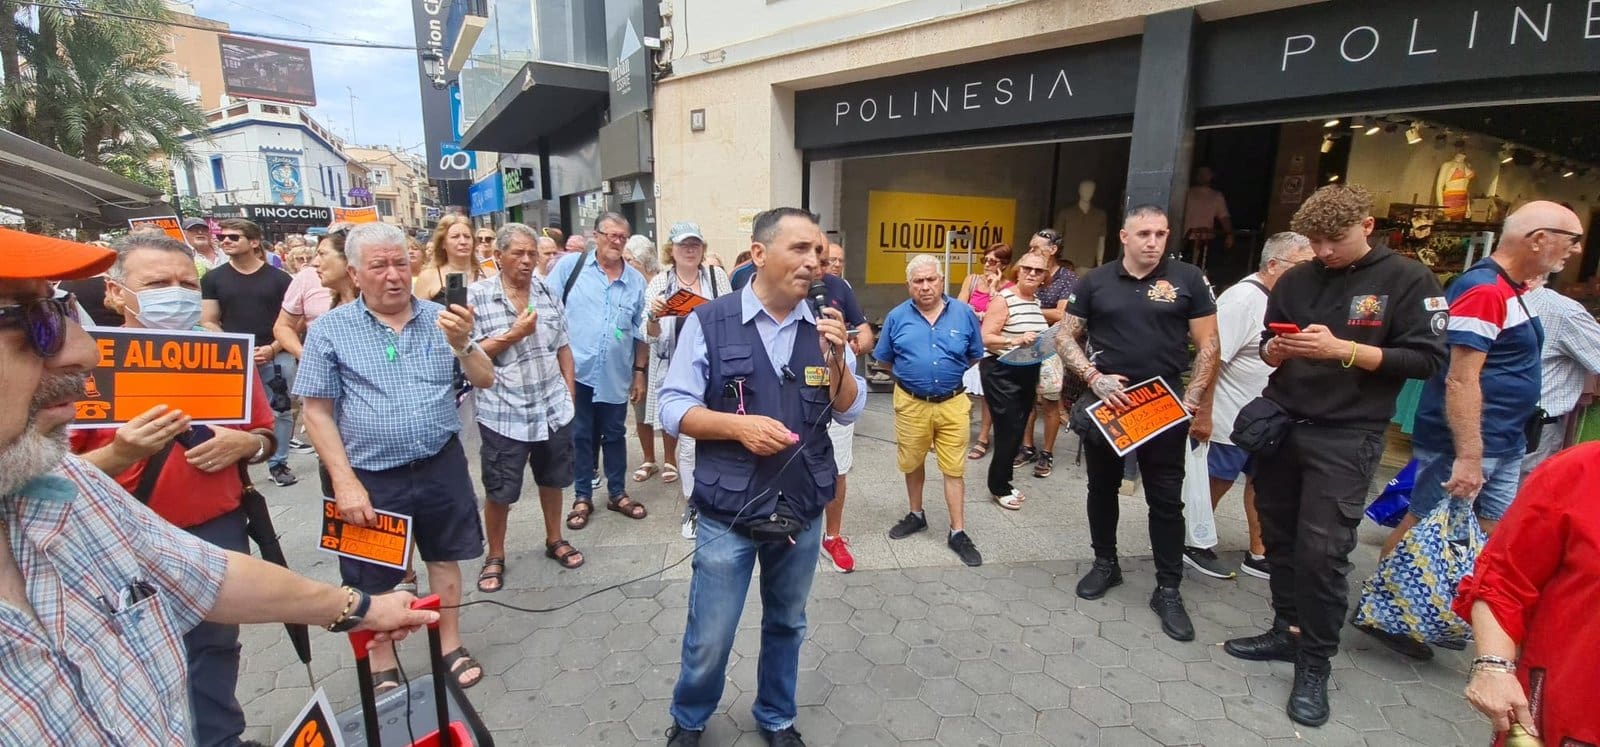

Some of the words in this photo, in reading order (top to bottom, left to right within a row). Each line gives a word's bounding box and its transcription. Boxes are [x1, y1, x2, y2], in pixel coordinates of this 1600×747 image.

[1282, 0, 1600, 71] POLINE
[836, 69, 1073, 126] POLINESIA
[254, 207, 328, 219] PINOCCHIO
[96, 338, 115, 368] E
[123, 339, 244, 370] ALQUILA
[1095, 406, 1115, 425] SE
